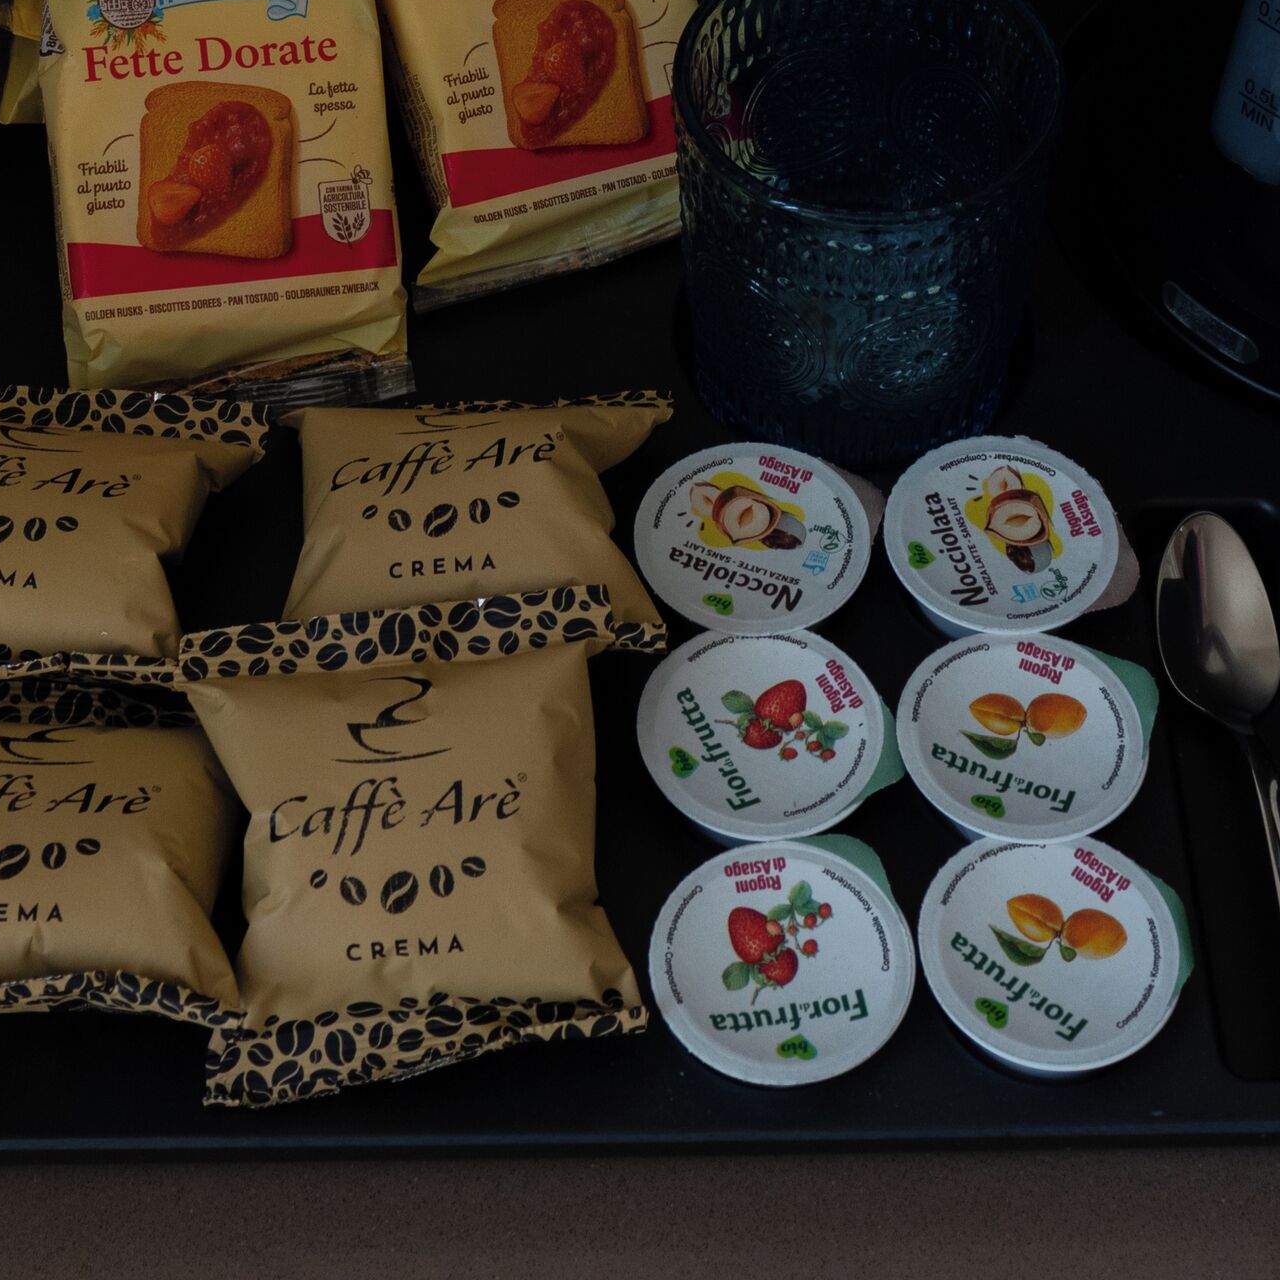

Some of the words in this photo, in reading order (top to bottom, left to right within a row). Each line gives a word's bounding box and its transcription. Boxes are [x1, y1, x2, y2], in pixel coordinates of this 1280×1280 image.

[82, 45, 184, 82] Fette
[195, 35, 337, 73] Dorate
[308, 82, 324, 97] La
[325, 80, 358, 98] fetta
[443, 68, 489, 88] Friabili
[313, 99, 356, 114] spessa
[446, 92, 461, 106] al
[461, 86, 495, 105] punto
[1243, 78, 1279, 111] 0.5L
[459, 104, 493, 125] giusto
[1239, 101, 1274, 132] MIN
[78, 161, 128, 178] Friabili
[77, 181, 92, 195] al
[93, 178, 132, 197] punto
[323, 191, 365, 203] AGRICOLTURA
[474, 211, 504, 224] GOLDEN
[504, 204, 528, 220] RUSKS
[533, 194, 570, 211] BISCOTTES
[570, 187, 598, 204] DOREES
[602, 182, 617, 193] PAN
[617, 175, 648, 190] TOSTADO
[86, 196, 126, 214] giusto
[324, 200, 367, 213] SOSTENIBILE
[85, 309, 116, 321] GOLDEN
[116, 306, 144, 319] RUSKS
[149, 302, 190, 315] BISCOTTES
[191, 298, 222, 311] DOREES
[228, 296, 243, 307] PAN
[244, 292, 279, 305] TOSTADO
[285, 286, 341, 301] GOLDBRAUNER
[342, 282, 380, 296] ZWIEBACK
[331, 439, 453, 496] Caffè
[678, 457, 733, 488] Composteerbaar
[758, 455, 801, 480] Asiago
[801, 468, 813, 483] di
[939, 453, 987, 472] Compostable
[993, 454, 1056, 477] Composteerbaar
[760, 470, 800, 495] Rigoni
[654, 489, 676, 530] Compostable
[947, 496, 962, 517] LAIT
[1060, 501, 1085, 537] Rigoni
[1071, 488, 1095, 525] Asiago
[957, 516, 972, 539] SANS
[1088, 524, 1101, 537] di
[682, 539, 706, 555] LAIT
[706, 548, 731, 563] SANS
[914, 543, 930, 567] bio
[925, 491, 988, 607] Nocciolata
[967, 543, 987, 570] LATTE
[389, 553, 498, 580] CREMA
[668, 547, 803, 612] Nocciolata
[735, 559, 767, 577] LATTE
[768, 569, 800, 586] SENZA
[982, 570, 998, 596] SENZA
[706, 595, 732, 611] bio
[687, 635, 734, 663] Compostable
[933, 643, 990, 676] Composteerbaar
[1017, 640, 1063, 667] Asiago
[825, 658, 856, 696] Asiago
[1019, 658, 1063, 685] Rigoni
[1062, 657, 1075, 672] di
[816, 672, 846, 714] Rigoni
[849, 694, 863, 709] di
[912, 678, 933, 723] Compostable
[676, 687, 730, 763] frutta
[677, 749, 694, 772] bio
[931, 743, 1013, 794] frutta
[718, 764, 761, 812] Fior
[1018, 779, 1076, 813] Fior
[269, 776, 407, 856] Caffè
[975, 795, 1001, 813] bio
[724, 859, 772, 879] Asiago
[773, 857, 786, 873] di
[1072, 847, 1119, 885] Asiago
[735, 873, 781, 894] Rigoni
[822, 867, 873, 913] Kompostierbar
[941, 863, 975, 906] Compostable
[1071, 865, 1114, 903] Rigoni
[1117, 877, 1131, 892] di
[666, 884, 703, 944] Composteerbaar
[347, 934, 464, 961] CREMA
[872, 915, 891, 972] Compostabile
[1146, 917, 1161, 977] Kompostierbar
[665, 950, 684, 1005] Compostable
[950, 931, 1031, 1003] frutta
[708, 1002, 802, 1033] frutta
[807, 988, 869, 1021] Fior
[979, 999, 1005, 1022] bio
[1029, 996, 1088, 1042] Fior
[780, 1039, 809, 1055] bio
